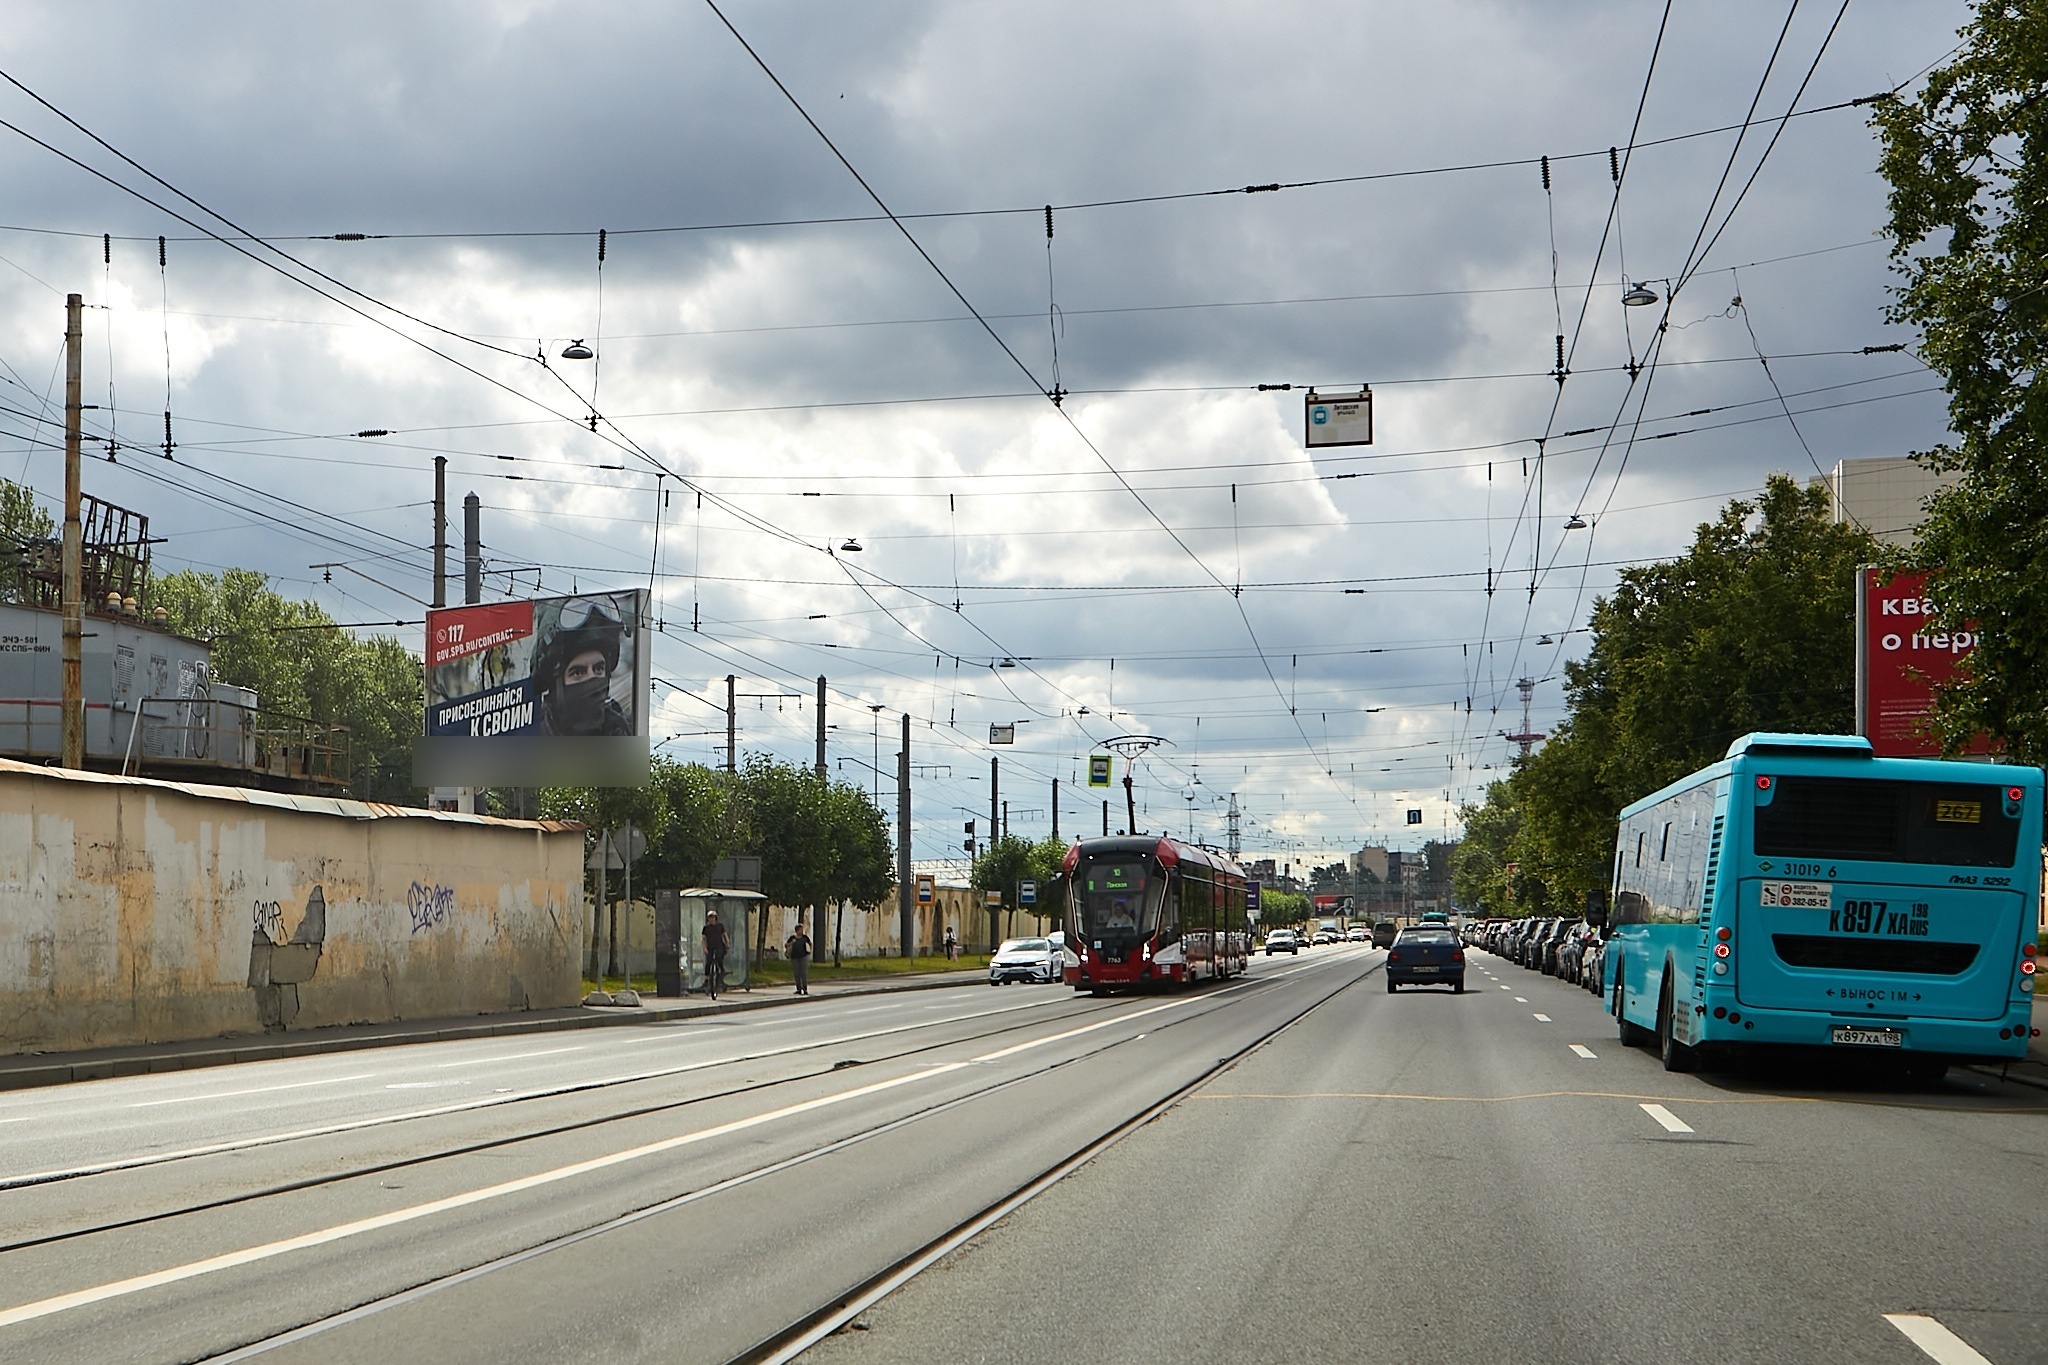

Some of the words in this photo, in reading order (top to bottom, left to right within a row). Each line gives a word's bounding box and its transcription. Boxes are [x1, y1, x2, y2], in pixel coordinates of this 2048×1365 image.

[447, 624, 465, 643] 117
[436, 631, 515, 662] GOV.SPB.RU/CONTRACT
[1881, 633, 1902, 650] о
[439, 686, 523, 727] ПРИСОЕДИНЯЙСЯ
[470, 716, 483, 736] К
[483, 702, 534, 736] СВОИМ
[1942, 805, 1974, 819] 267
[1113, 868, 1120, 876] 10
[1784, 863, 1821, 876] 31019
[1828, 866, 1837, 878] 6
[1982, 876, 2011, 886] 5292
[1911, 903, 1929, 918] 198
[1909, 919, 1929, 936] RUS
[1841, 988, 1886, 1000] ВЫНОС
[1882, 1033, 1899, 1042] 198
